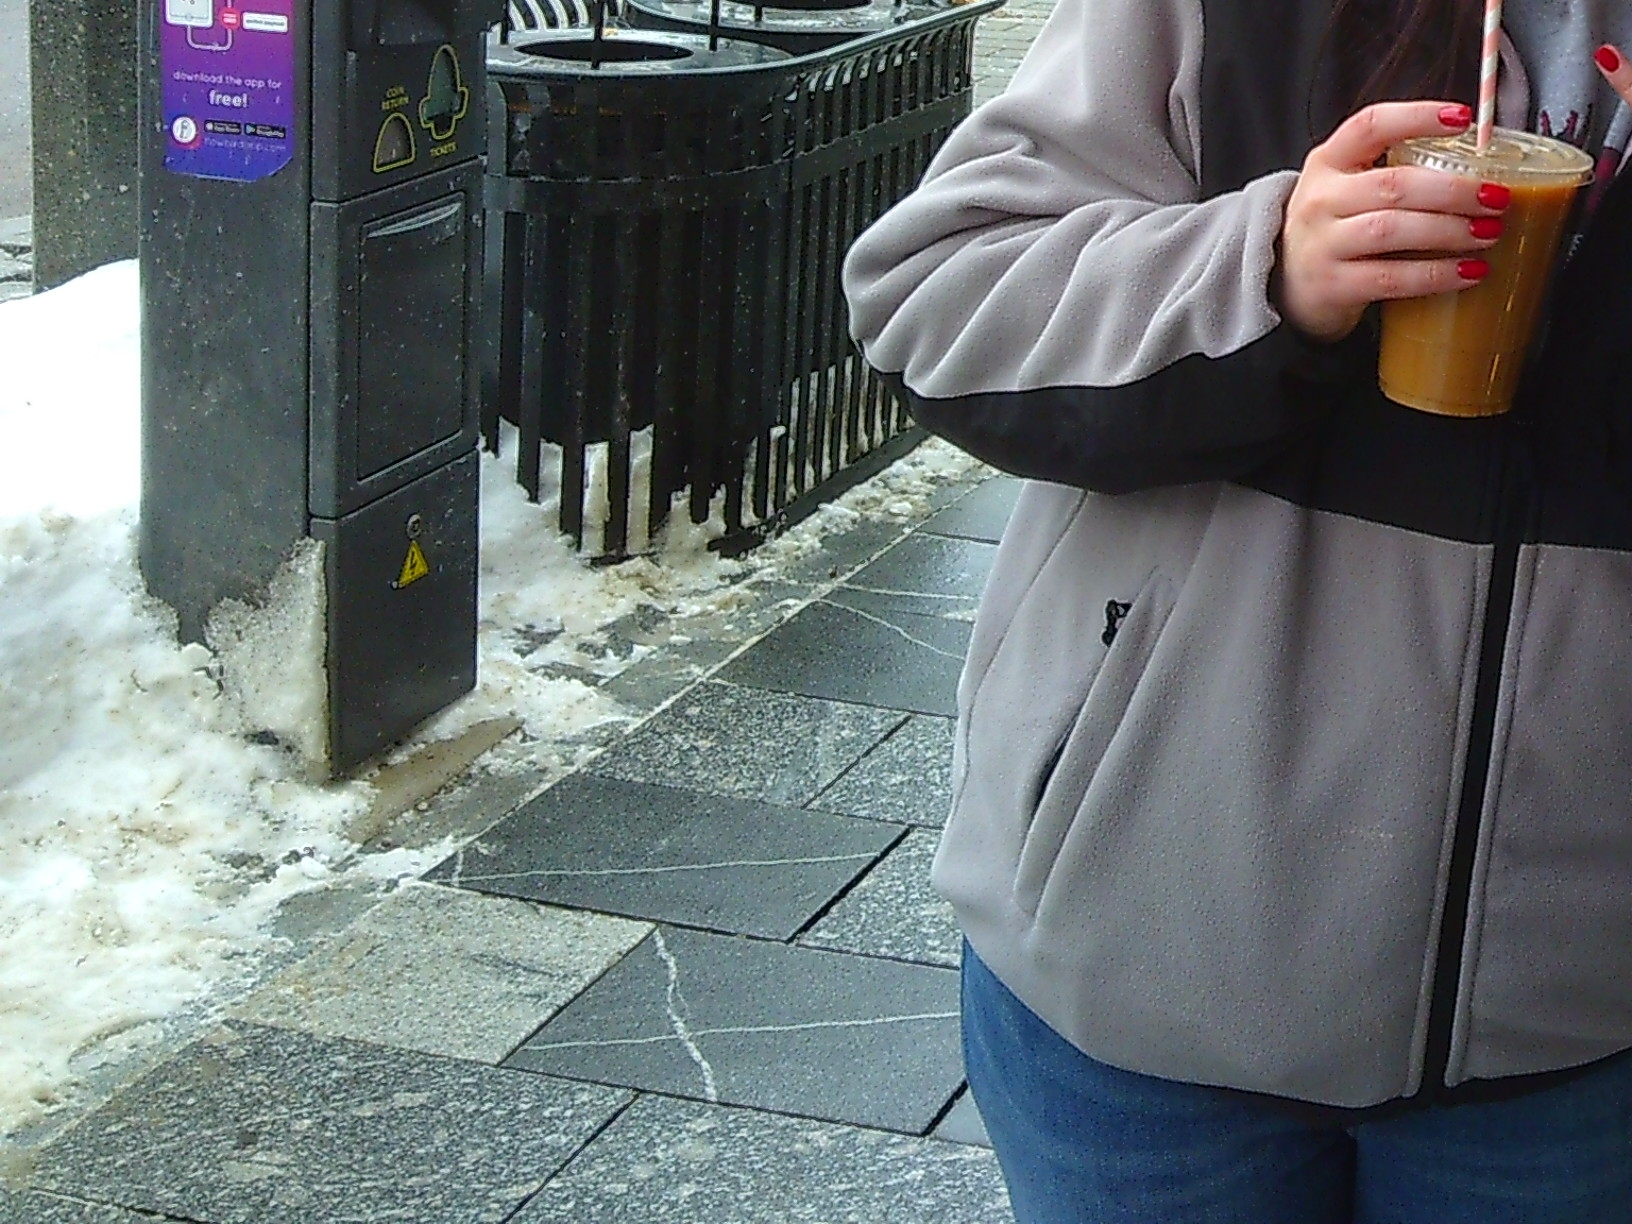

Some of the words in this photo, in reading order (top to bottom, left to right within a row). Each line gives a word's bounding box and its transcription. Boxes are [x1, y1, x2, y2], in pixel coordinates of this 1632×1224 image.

[225, 75, 243, 86] the
[244, 79, 265, 89] app
[208, 89, 248, 108] free!
